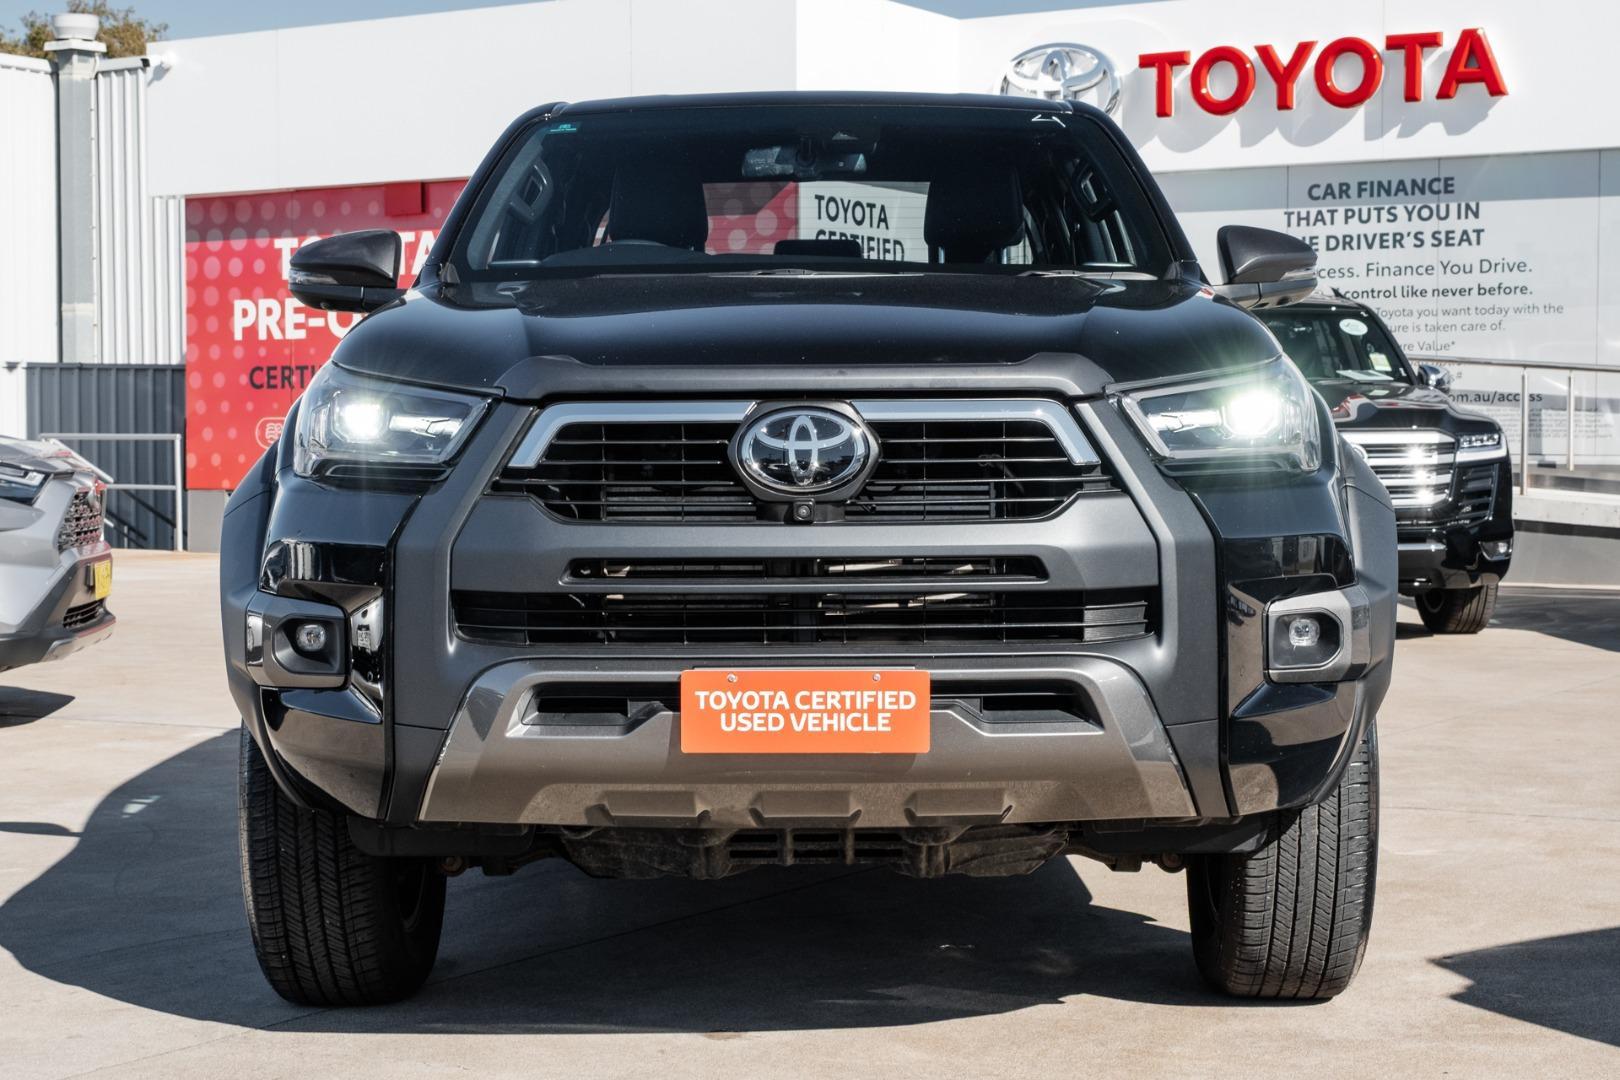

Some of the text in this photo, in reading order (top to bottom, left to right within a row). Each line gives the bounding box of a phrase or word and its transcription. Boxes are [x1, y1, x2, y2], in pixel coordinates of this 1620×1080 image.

[1138, 27, 1509, 118] TOYOTA
[1307, 177, 1455, 201] CAR FINANCE
[814, 194, 889, 231] TOYOTA
[1284, 202, 1480, 228] THAT PUTS YOU IN
[1325, 231, 1425, 251] DRIVER'S
[1431, 229, 1485, 248] SEAT
[1318, 258, 1533, 279] cess. Finance You Drive.
[1401, 285, 1428, 299] like
[1431, 287, 1474, 298] never
[1477, 283, 1533, 297] before.
[1375, 303, 1565, 319] Toyota you want today with the
[1412, 322, 1421, 333] is
[1424, 321, 1457, 333] taken
[1461, 322, 1487, 332] care
[1490, 320, 1506, 332] of.
[694, 690, 917, 711] TOYOTA CERTIFIED
[720, 712, 892, 732] USED VEHICLE
